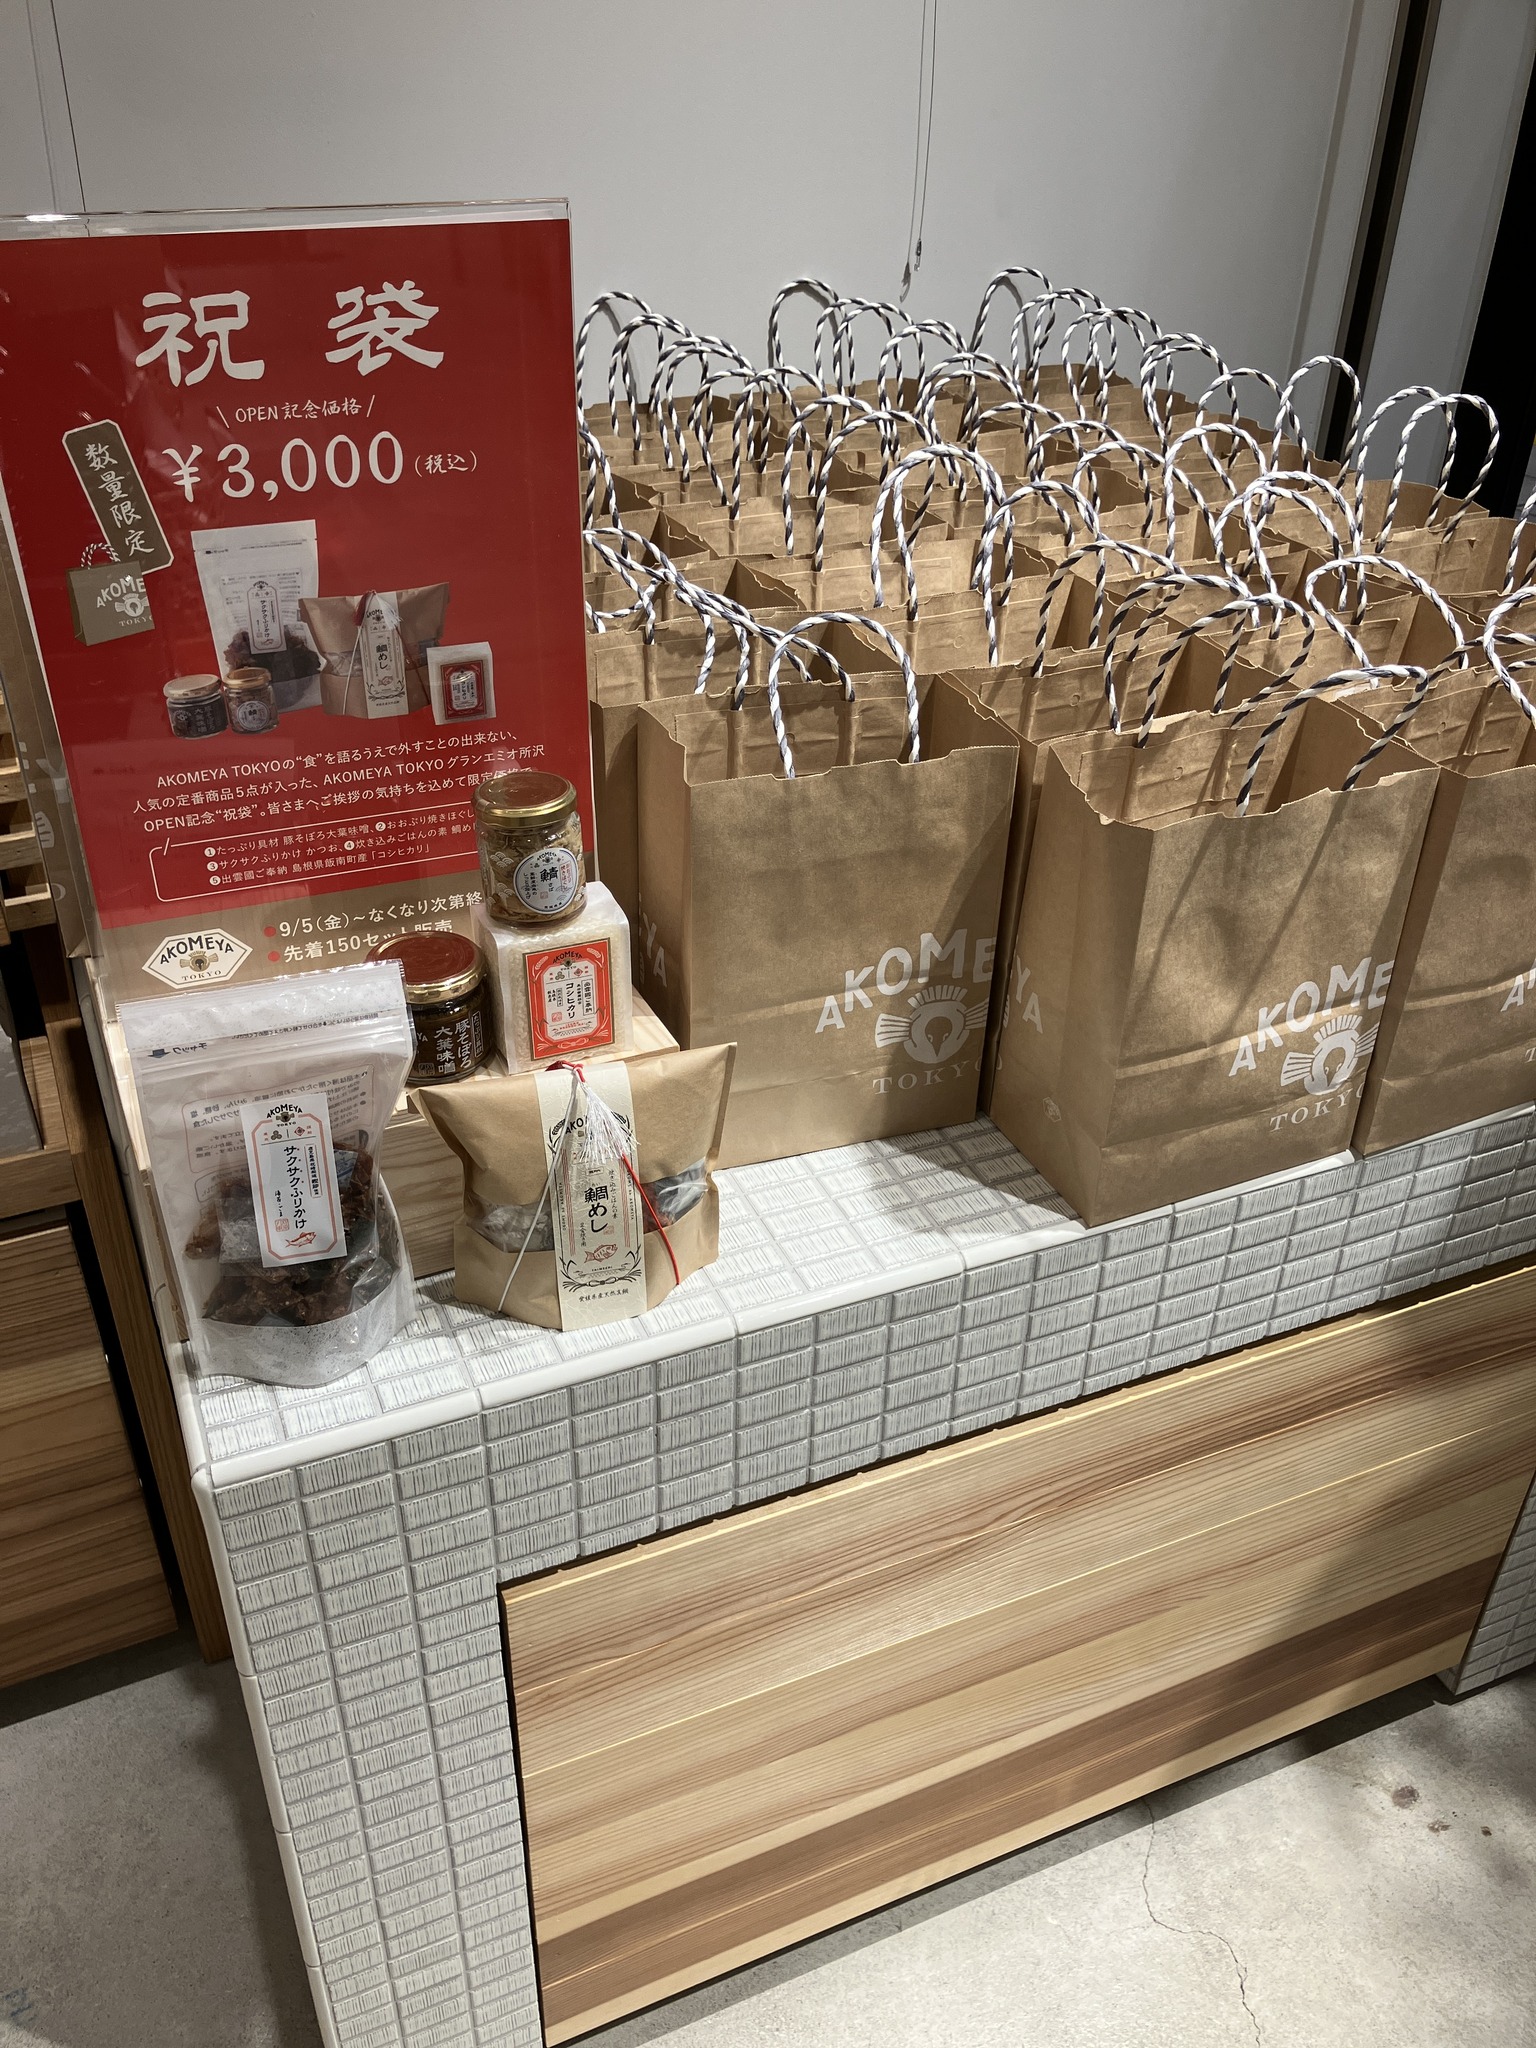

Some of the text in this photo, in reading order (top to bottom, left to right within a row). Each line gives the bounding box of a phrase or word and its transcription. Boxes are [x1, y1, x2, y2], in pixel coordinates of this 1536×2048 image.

[162, 430, 403, 503] ¥3,000
[84, 442, 155, 558] 数量限定
[157, 768, 228, 788] AKOMEYA
[323, 766, 392, 785] AKOMEYA
[159, 935, 235, 965] AKOMEYA
[181, 969, 222, 982] TOKYO
[566, 982, 576, 1019] コシヒカリ
[455, 1019, 472, 1069] 豚そぼろ
[266, 1104, 303, 1119] AKOMEYA
[284, 1145, 307, 1229] サクサクふりかけ
[584, 1185, 608, 1233] 鯛めし
